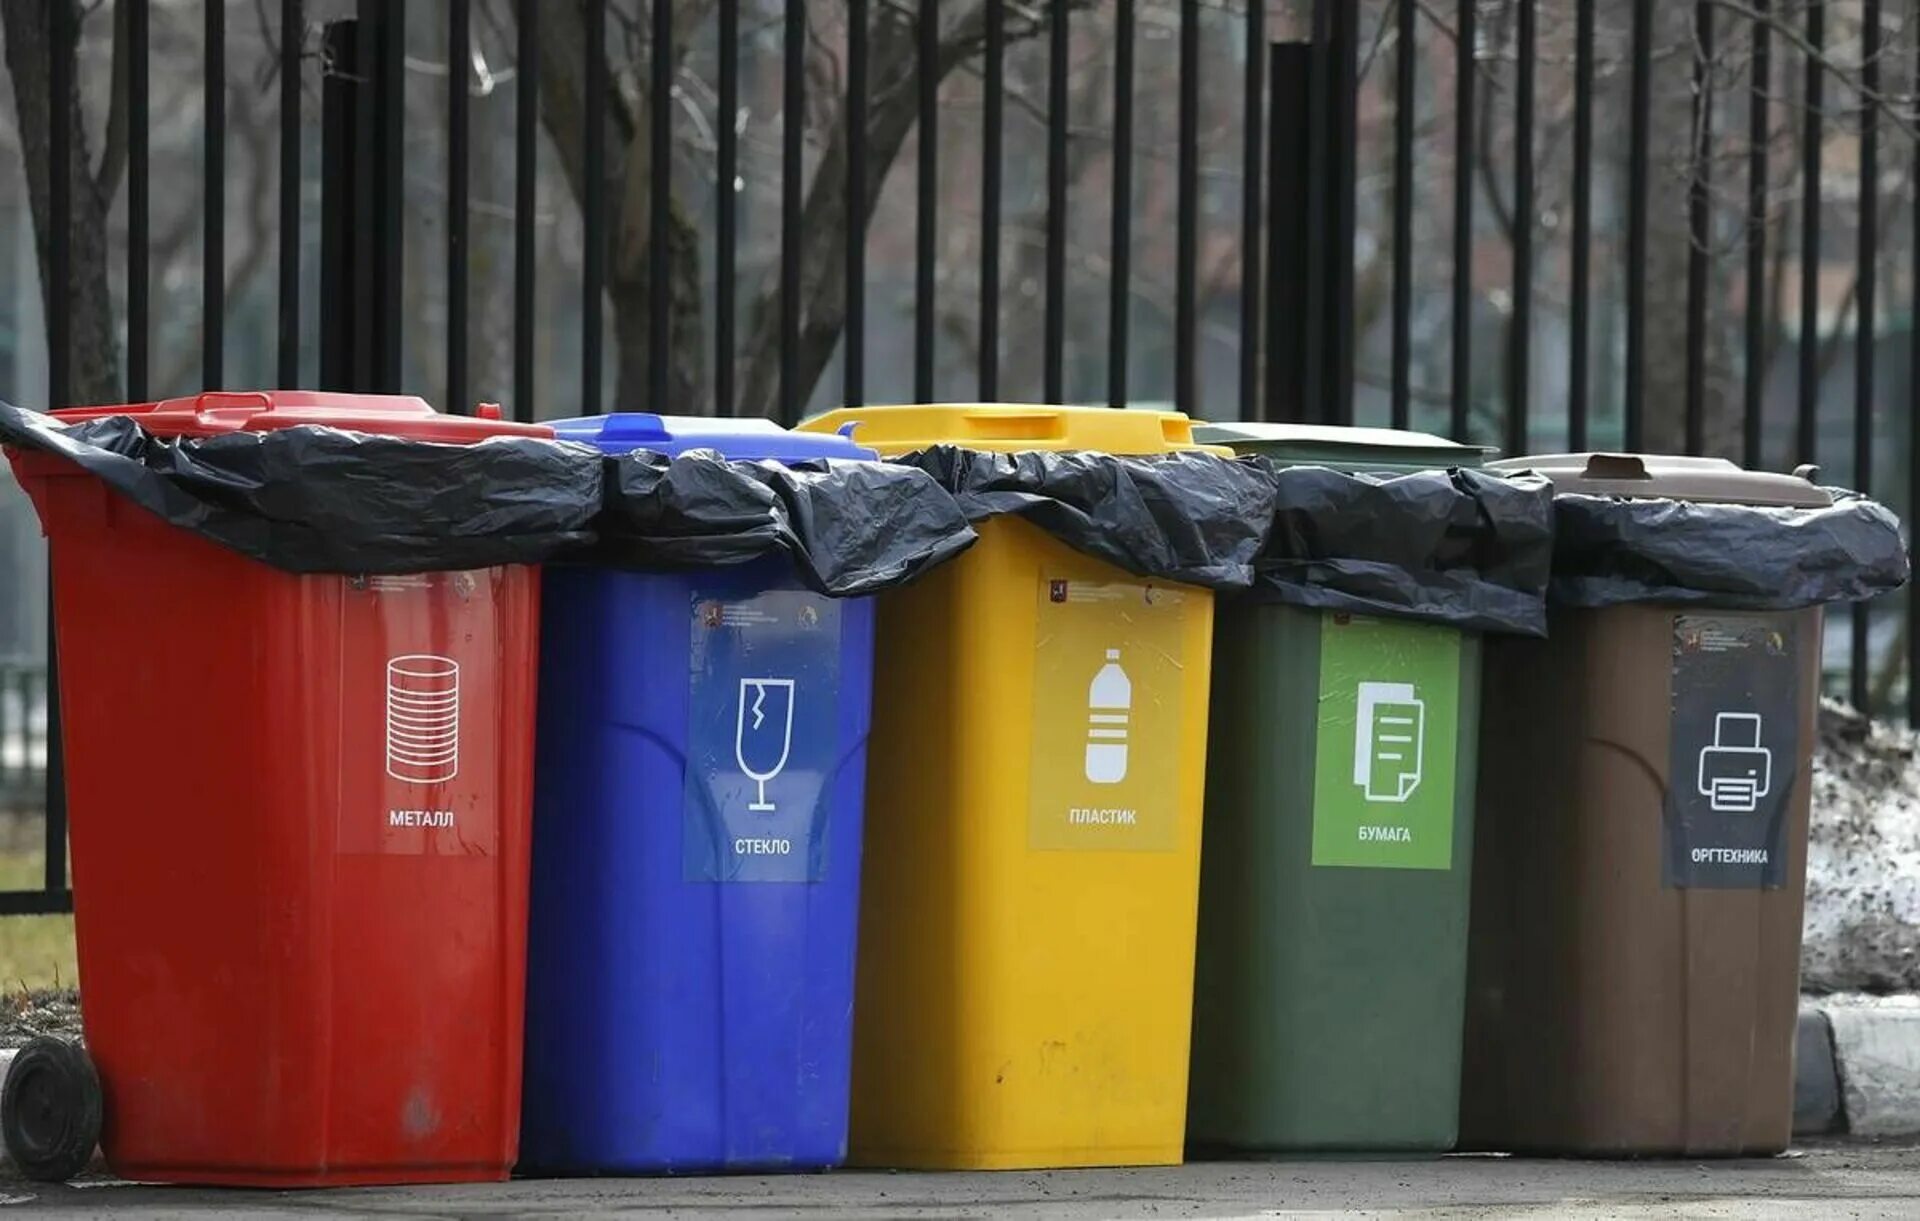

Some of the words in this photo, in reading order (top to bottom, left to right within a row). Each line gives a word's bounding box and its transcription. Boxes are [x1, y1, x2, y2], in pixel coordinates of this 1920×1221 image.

[390, 811, 453, 827] МЕТАЛЛ
[1070, 809, 1136, 824] ПЛАСТИК
[1358, 826, 1412, 842] БУМАГА
[735, 839, 790, 854] СТЕКЛО
[1692, 848, 1768, 863] ОРГТЕХНИКА
